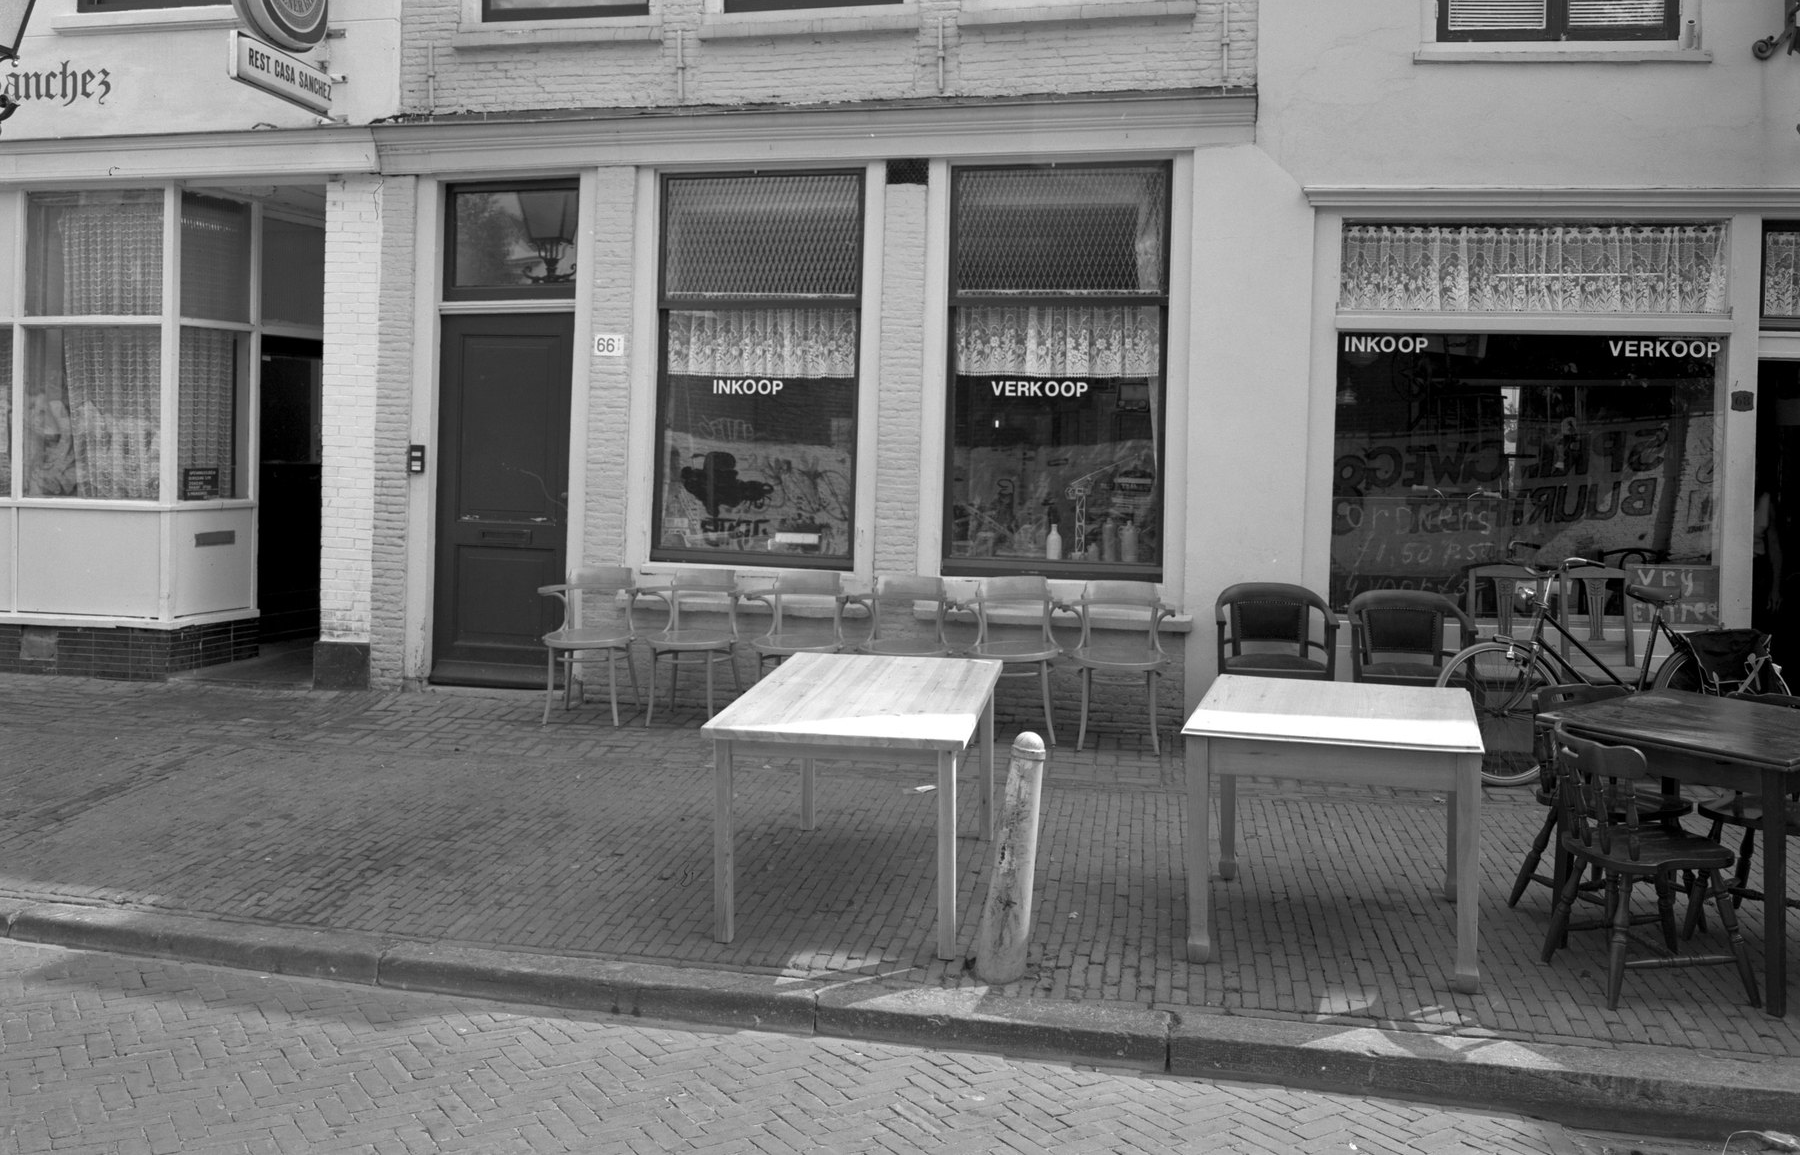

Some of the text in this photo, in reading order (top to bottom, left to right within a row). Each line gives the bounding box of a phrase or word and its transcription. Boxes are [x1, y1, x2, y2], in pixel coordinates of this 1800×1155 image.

[0, 60, 111, 107] anchez
[274, 59, 296, 85] CASA
[299, 71, 332, 102] SANCHEZ
[597, 337, 615, 353] 66
[1344, 336, 1429, 354] INKOOP
[1609, 340, 1721, 358] VERKOOP
[713, 379, 783, 395] INKOOP
[991, 381, 1088, 397] VERKOOP
